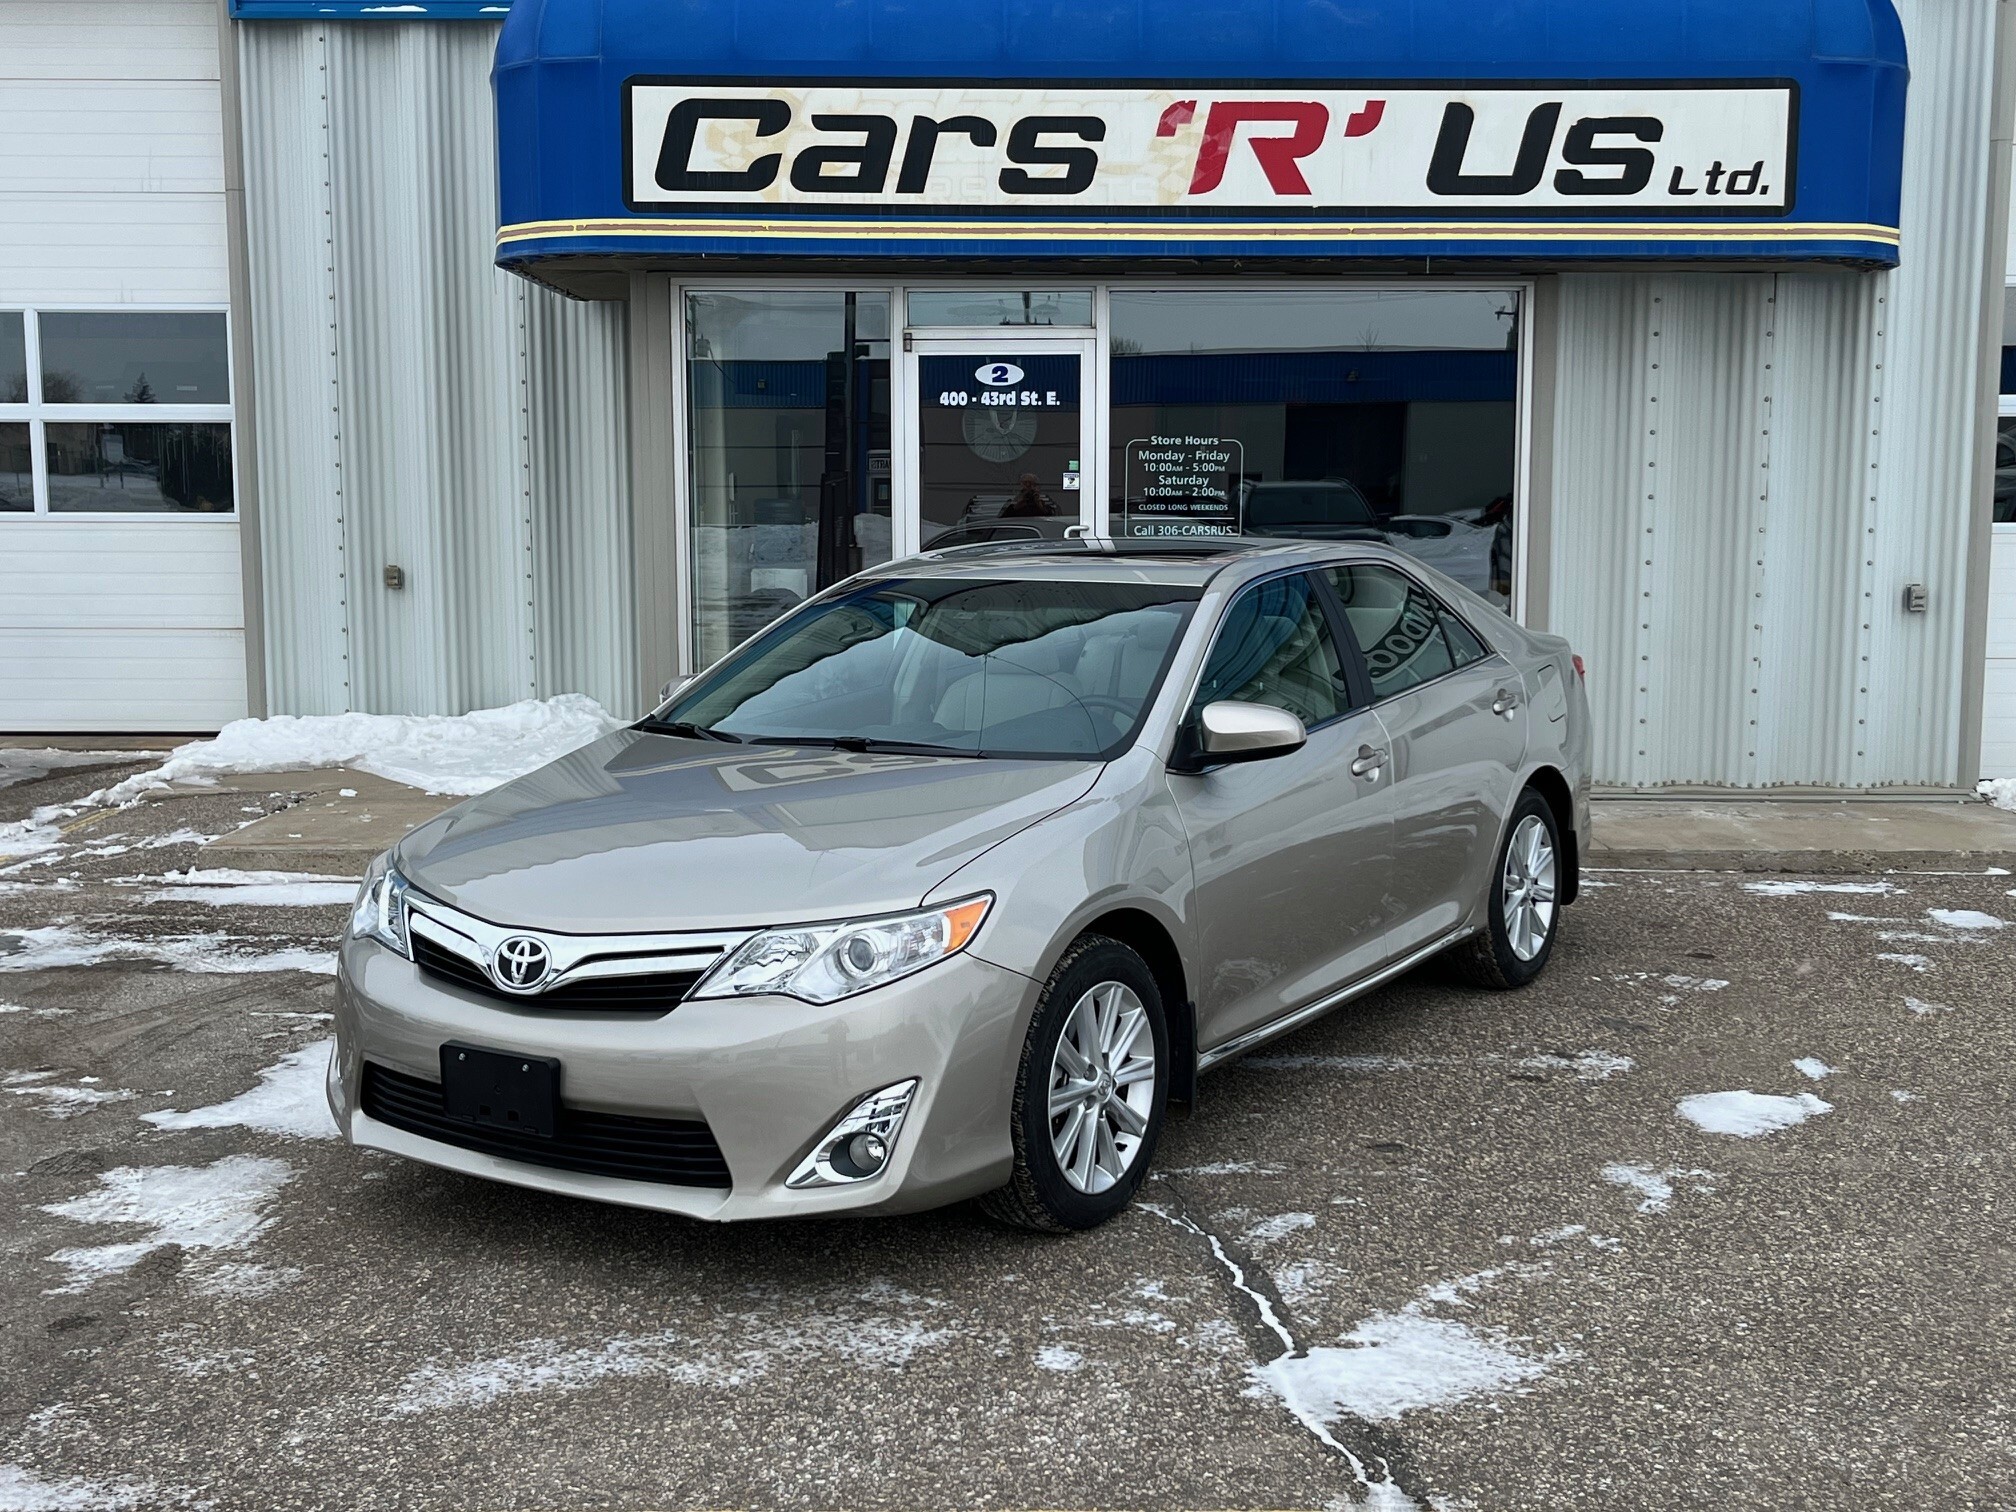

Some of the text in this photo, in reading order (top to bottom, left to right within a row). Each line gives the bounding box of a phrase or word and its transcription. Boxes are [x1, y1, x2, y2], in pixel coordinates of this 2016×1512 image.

[655, 98, 1106, 194] Cars
[1427, 101, 1663, 195] Us
[1668, 160, 1770, 196] Ltd.
[992, 365, 1009, 383] 2
[939, 391, 968, 406] 400
[980, 391, 1016, 406] 43rd
[1020, 391, 1042, 406] St.
[1046, 391, 1061, 406] E.
[1151, 435, 1219, 445] Store Hours
[1138, 450, 1185, 463] Monday
[1195, 450, 1231, 463] Friday
[1158, 474, 1210, 488] Saturday
[1134, 525, 1233, 536] Call 306-CARSRUS
